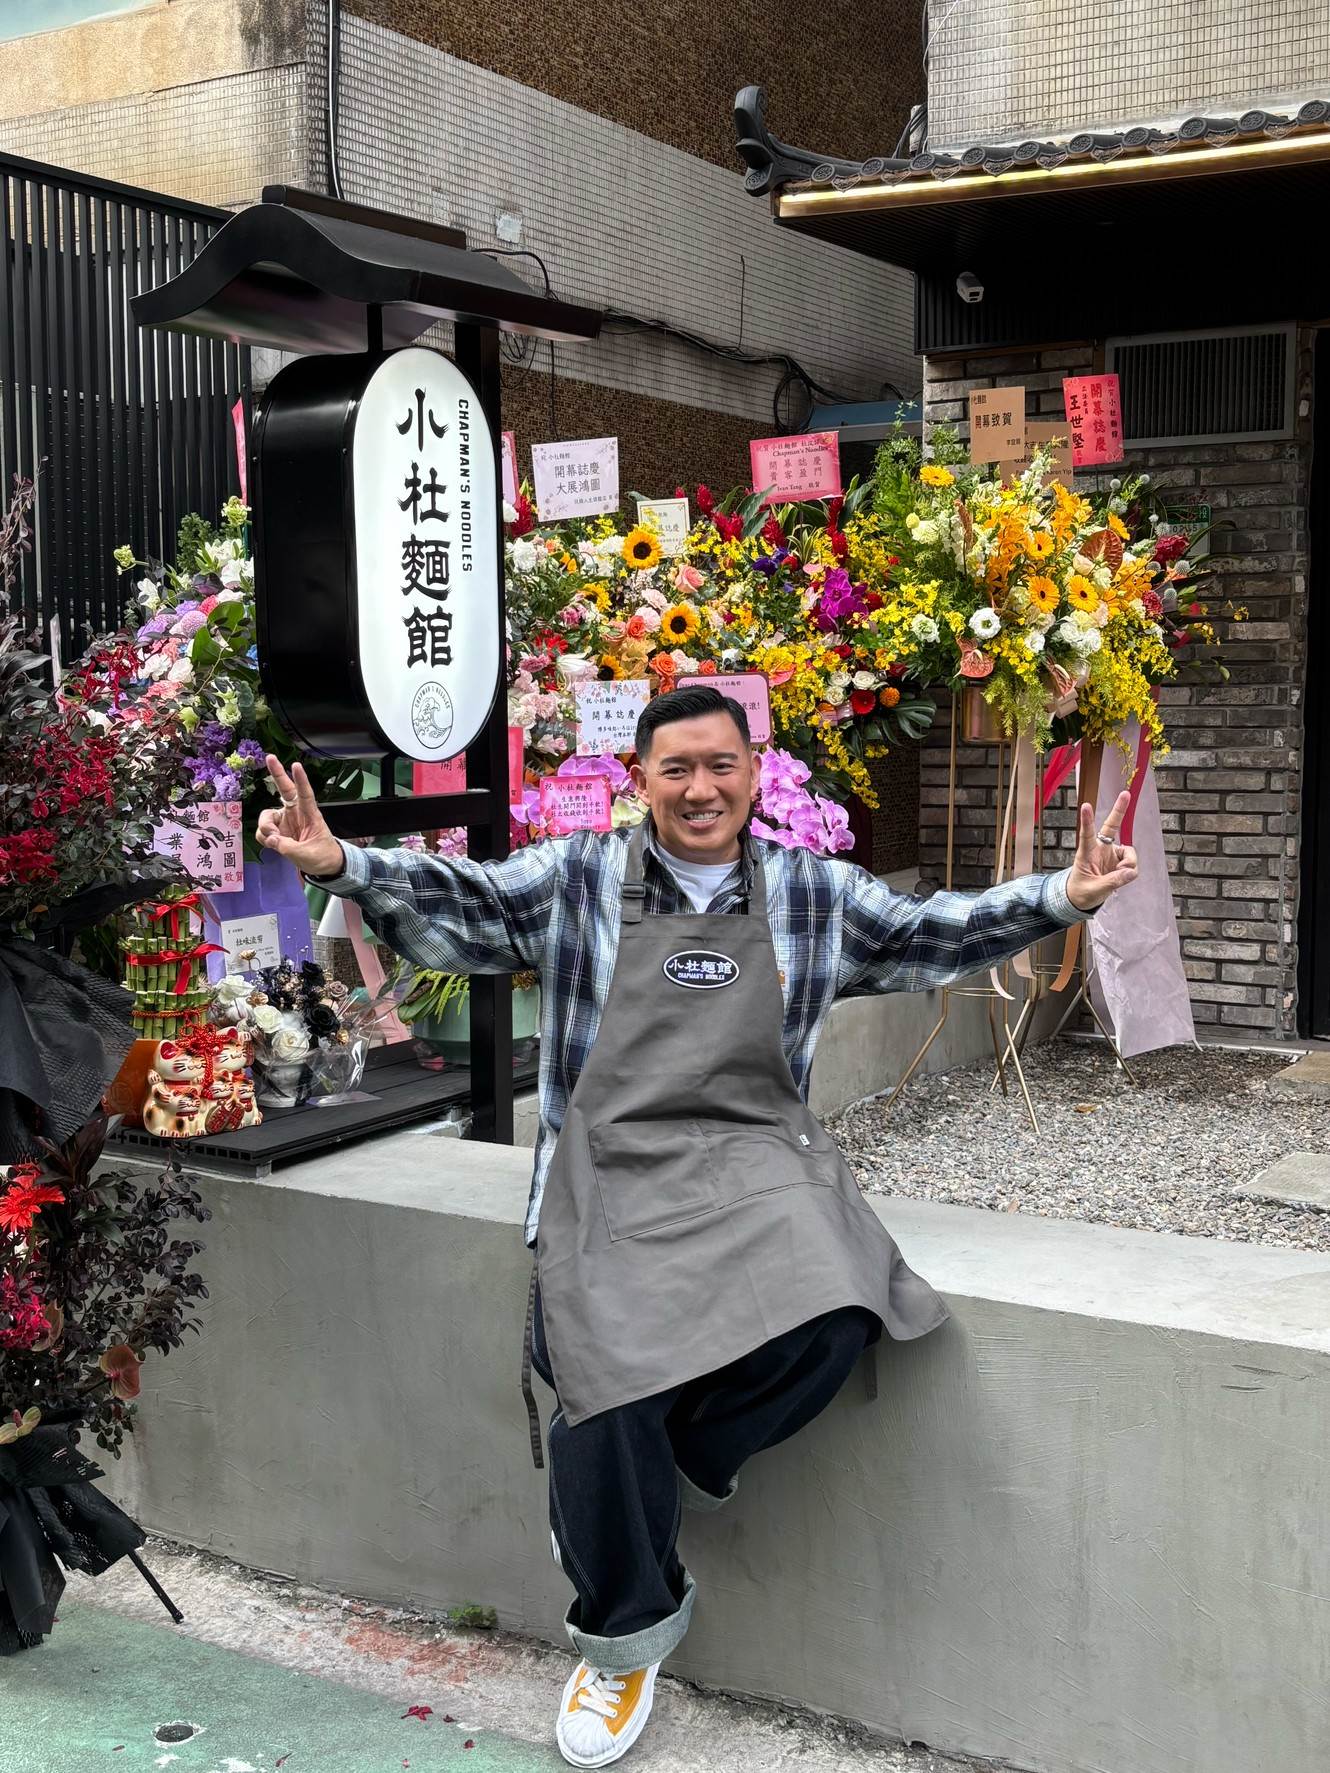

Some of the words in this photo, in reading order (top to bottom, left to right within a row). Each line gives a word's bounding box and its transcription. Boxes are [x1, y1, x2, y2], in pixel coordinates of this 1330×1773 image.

[1070, 394, 1084, 450] 王世堅
[1091, 383, 1107, 453] 開幕誌慶
[458, 399, 471, 494] CHAPMAN'S
[772, 448, 804, 457] Chapman's
[554, 461, 600, 479] 開幕誌慶
[769, 456, 822, 470] 開幕誌慶
[556, 478, 601, 496] 大展鴻圖
[396, 387, 454, 668] 小杜麵館
[460, 500, 473, 572] NOODLES
[592, 709, 635, 721] 開幕誌慶
[558, 782, 593, 793] 小杜麵館
[668, 959, 732, 974] 小杜麵館
[678, 972, 704, 980] CHAPMAN'S
